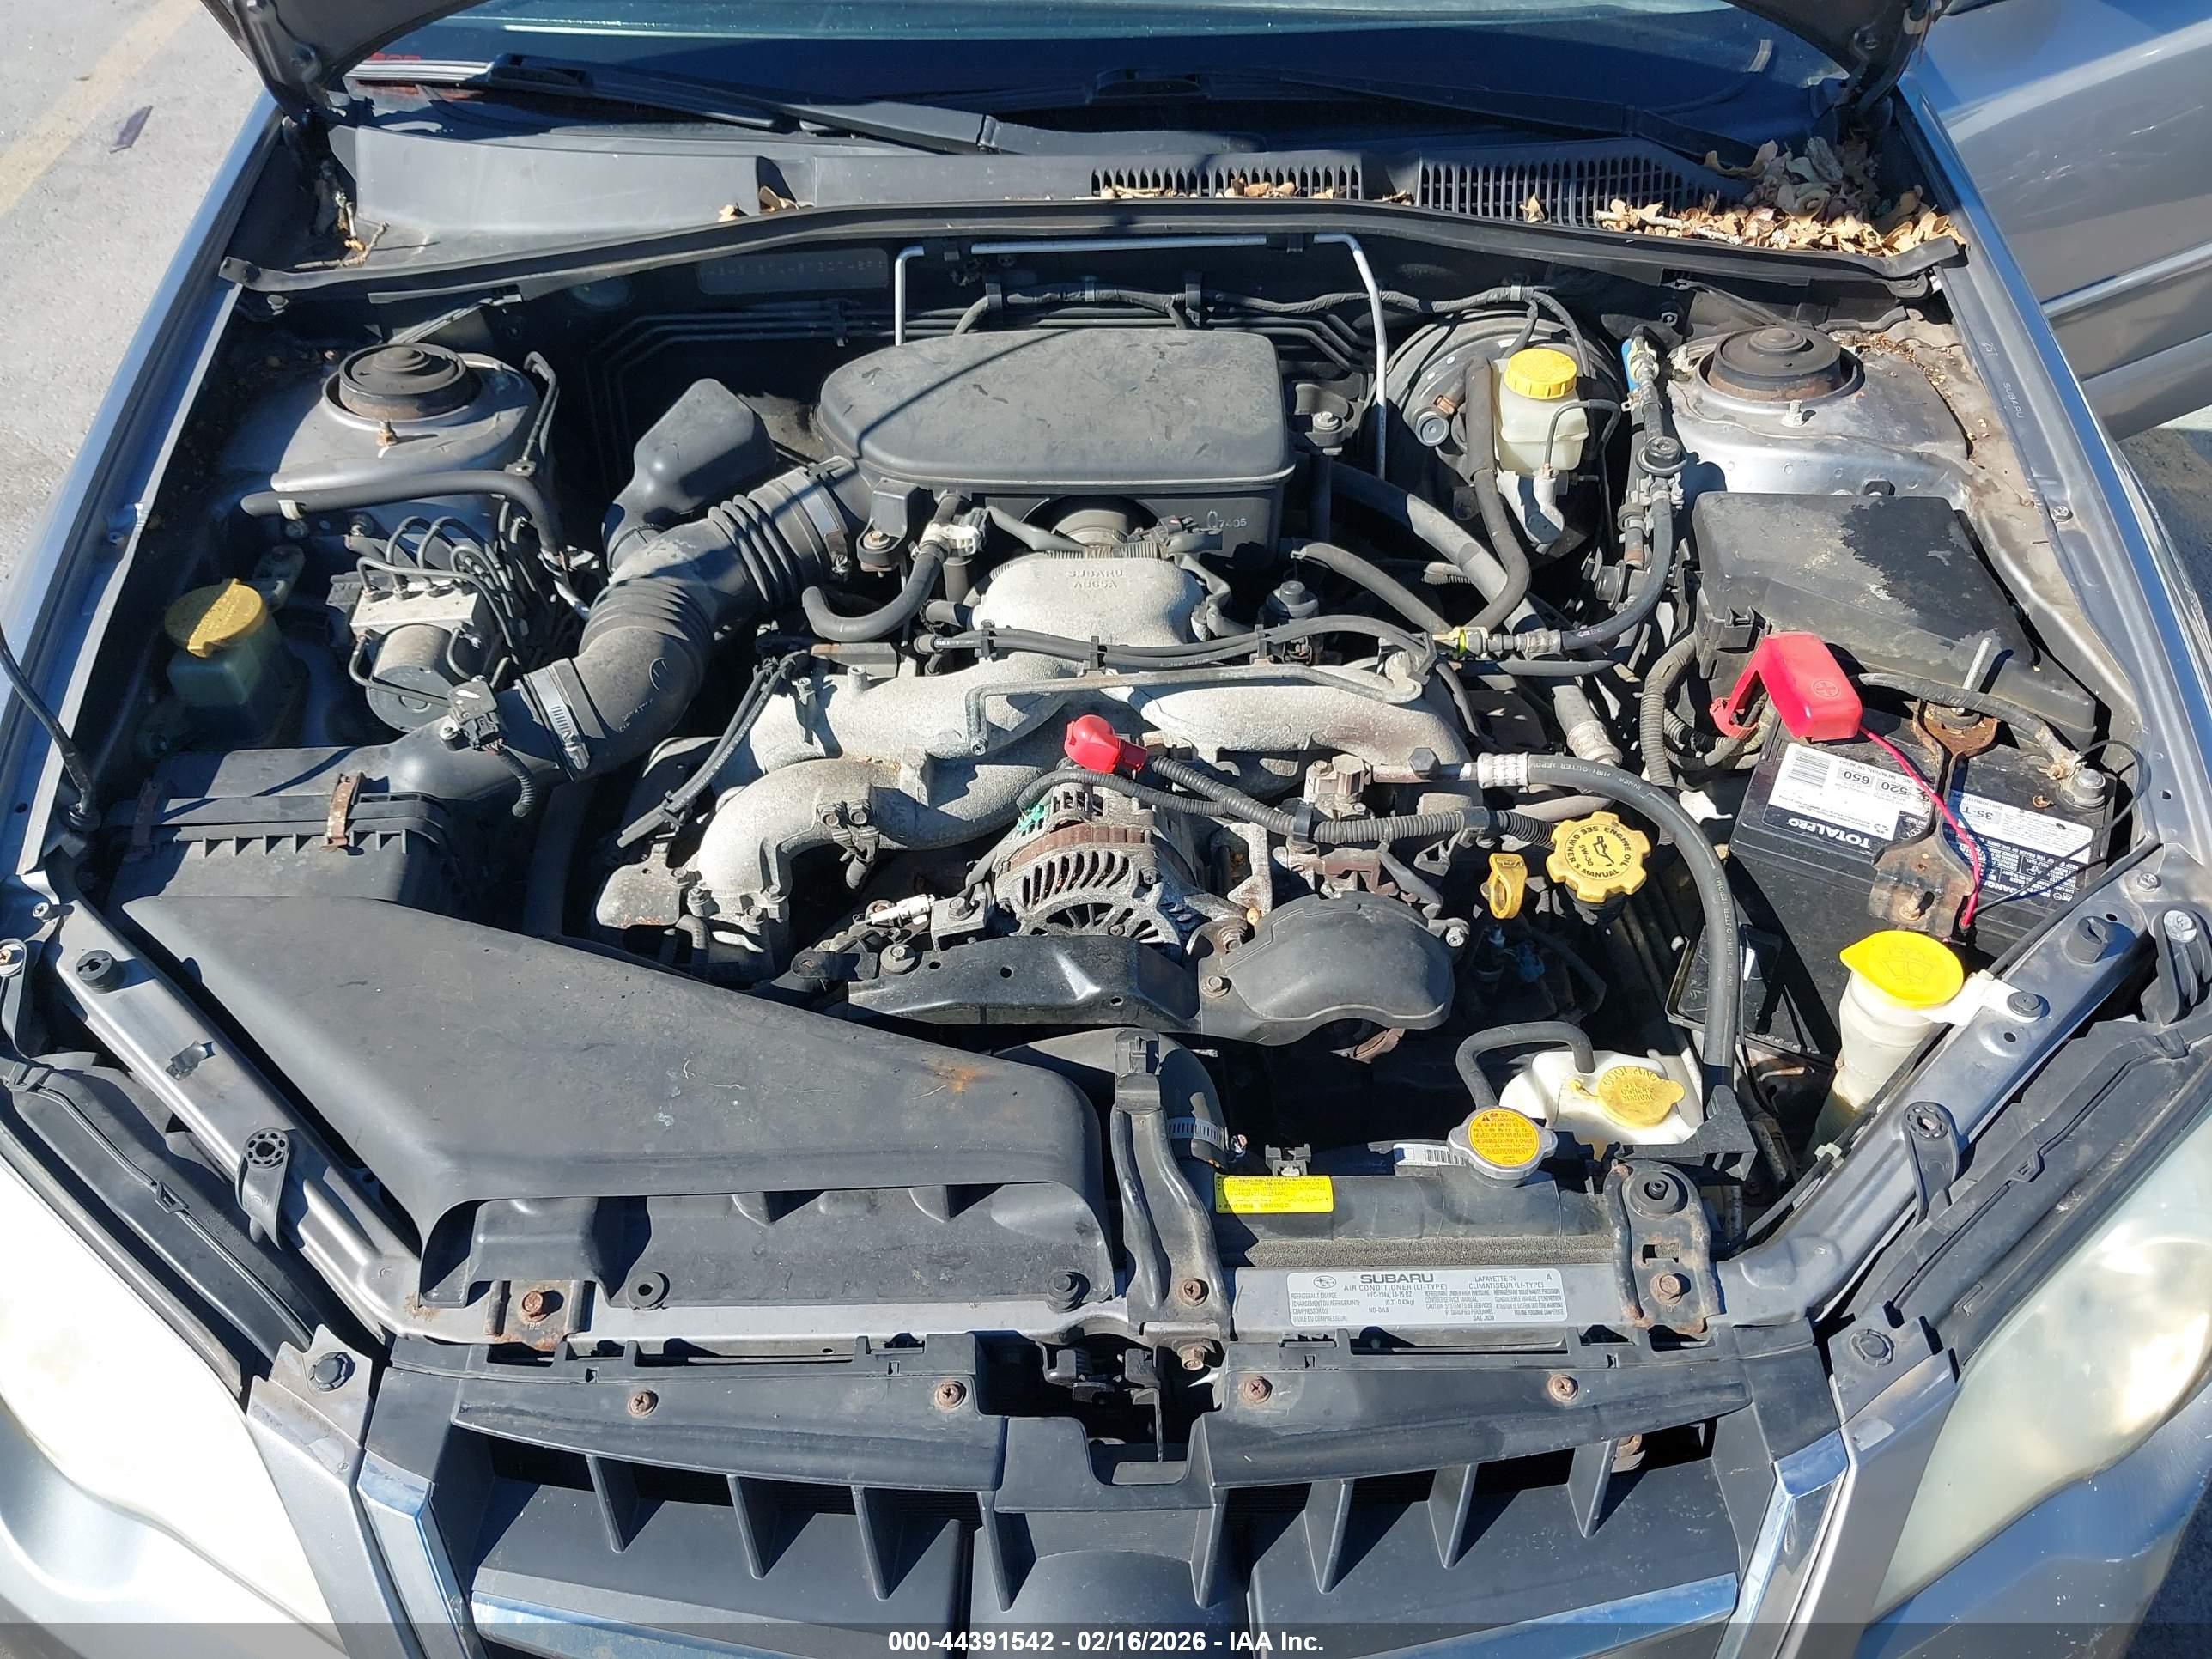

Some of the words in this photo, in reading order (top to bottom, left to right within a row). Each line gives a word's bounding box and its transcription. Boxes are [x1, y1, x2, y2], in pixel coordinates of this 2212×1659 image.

[2002, 381, 2026, 420] SUBARU
[1066, 569, 1123, 578] SUBARU
[1842, 769, 1869, 785] 650
[1881, 781, 1908, 796] 520
[1961, 805, 1993, 821] 35-T
[1580, 825, 1599, 835] SEE
[1785, 813, 1872, 849] TOTALPRO
[1603, 827, 1632, 851] ENGINE
[1620, 853, 1632, 866] OIL
[1581, 867, 1620, 878] MANUAL
[1360, 1273, 1434, 1284] SUBARU
